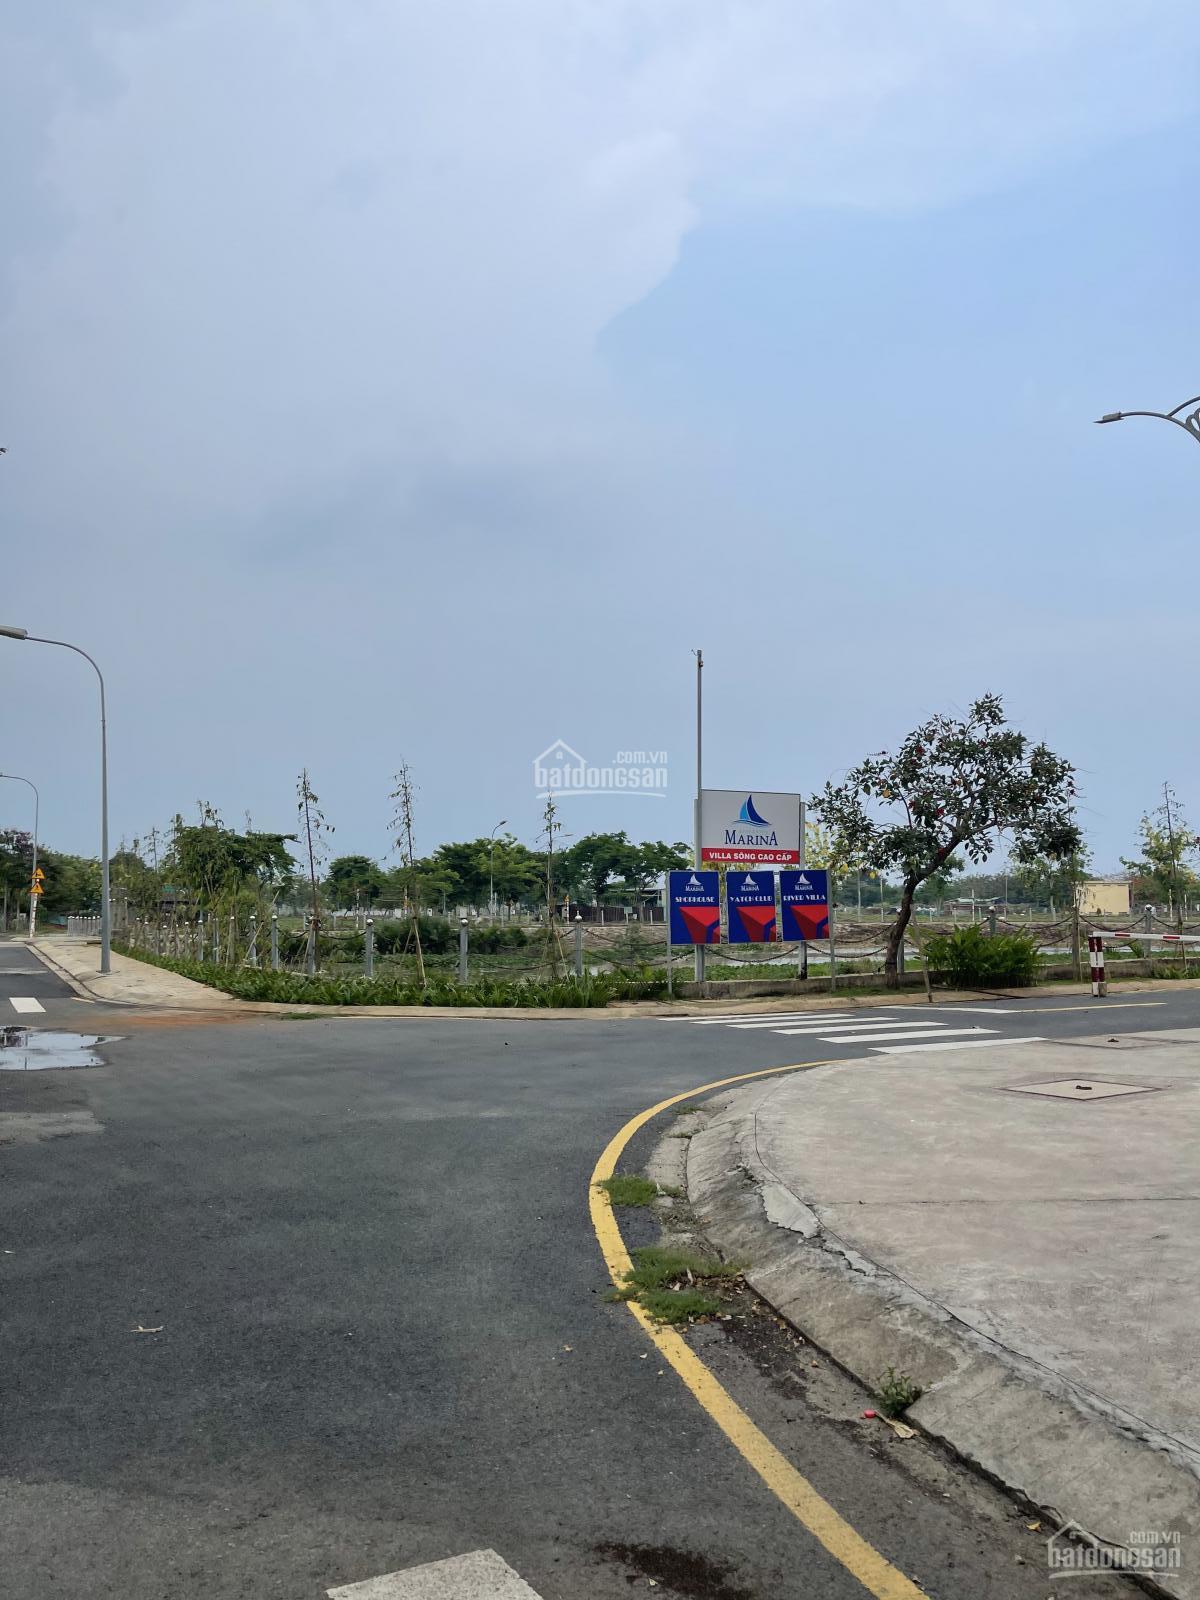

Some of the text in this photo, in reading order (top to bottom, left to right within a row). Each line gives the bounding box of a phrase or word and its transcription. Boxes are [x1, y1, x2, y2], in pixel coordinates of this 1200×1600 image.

[734, 851, 756, 860] SÔNG
[758, 853, 774, 861] CAO
[776, 851, 792, 861] CẤP
